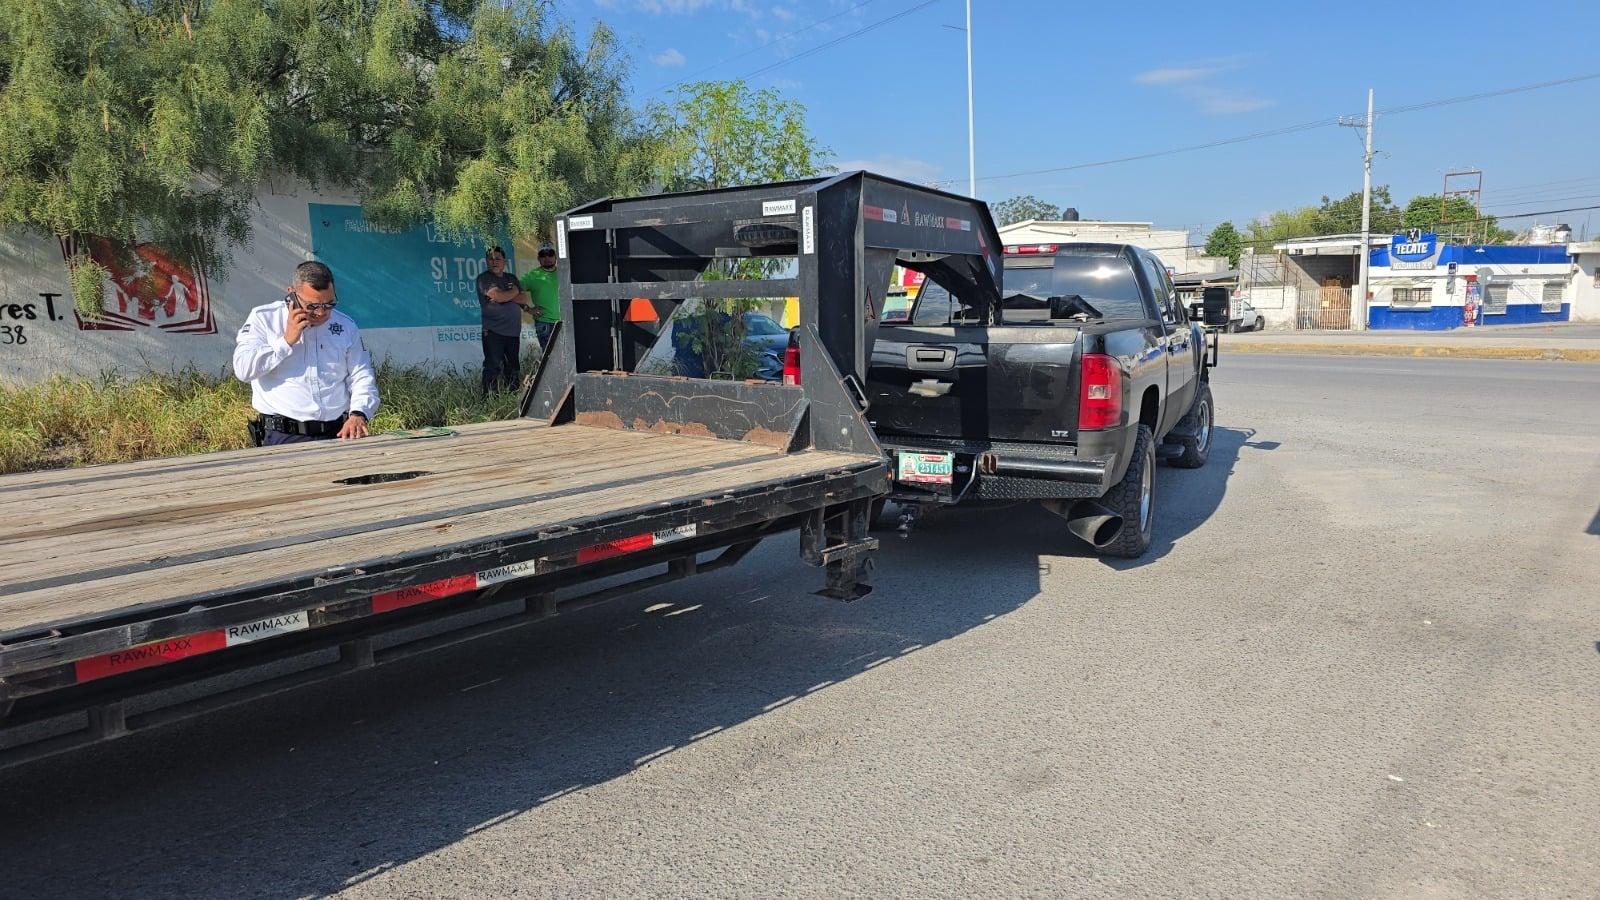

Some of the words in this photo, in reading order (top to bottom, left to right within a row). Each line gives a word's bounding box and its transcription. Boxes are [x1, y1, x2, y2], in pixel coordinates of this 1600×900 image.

[1395, 242, 1430, 255] TECATE
[430, 256, 449, 280] SI
[433, 281, 454, 294] TU
[39, 293, 64, 321] T.
[0, 325, 28, 345] 38
[1051, 430, 1069, 438] LTZ
[478, 562, 530, 581] RAWMAXX
[109, 639, 192, 667] RAWMAXX
[229, 613, 301, 639] RAWMAXX
